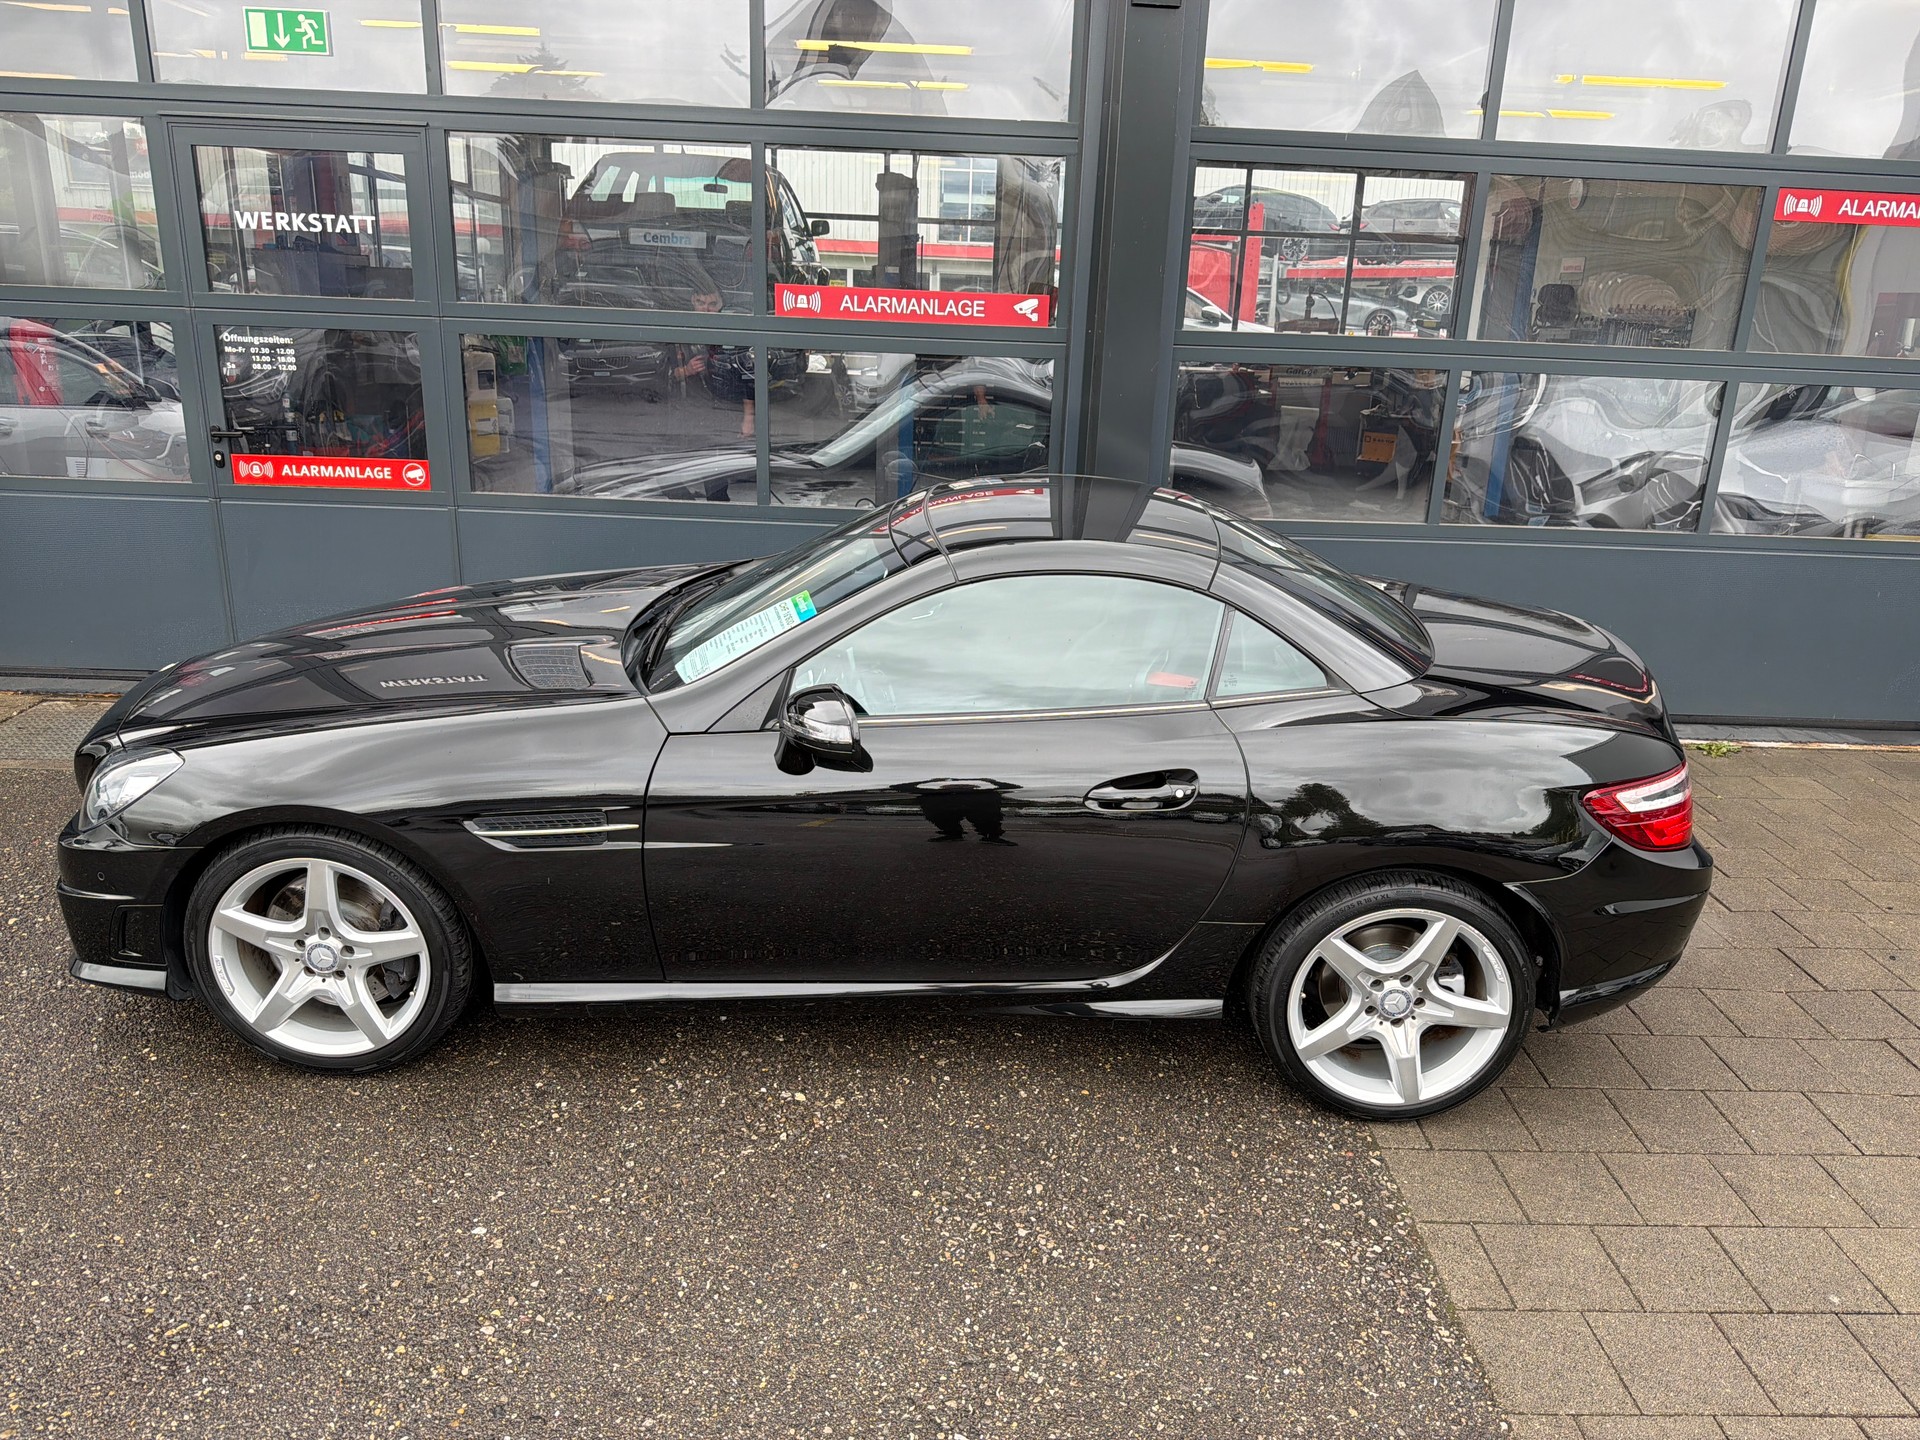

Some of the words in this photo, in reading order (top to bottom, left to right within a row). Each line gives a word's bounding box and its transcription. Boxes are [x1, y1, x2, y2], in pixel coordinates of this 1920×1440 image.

[1838, 199, 1920, 218] ALARMA
[234, 210, 376, 234] WERKSTATT
[643, 231, 692, 245] Cembra
[840, 294, 985, 318] ALARMANLAGE
[281, 464, 392, 479] ALARMANLAGE
